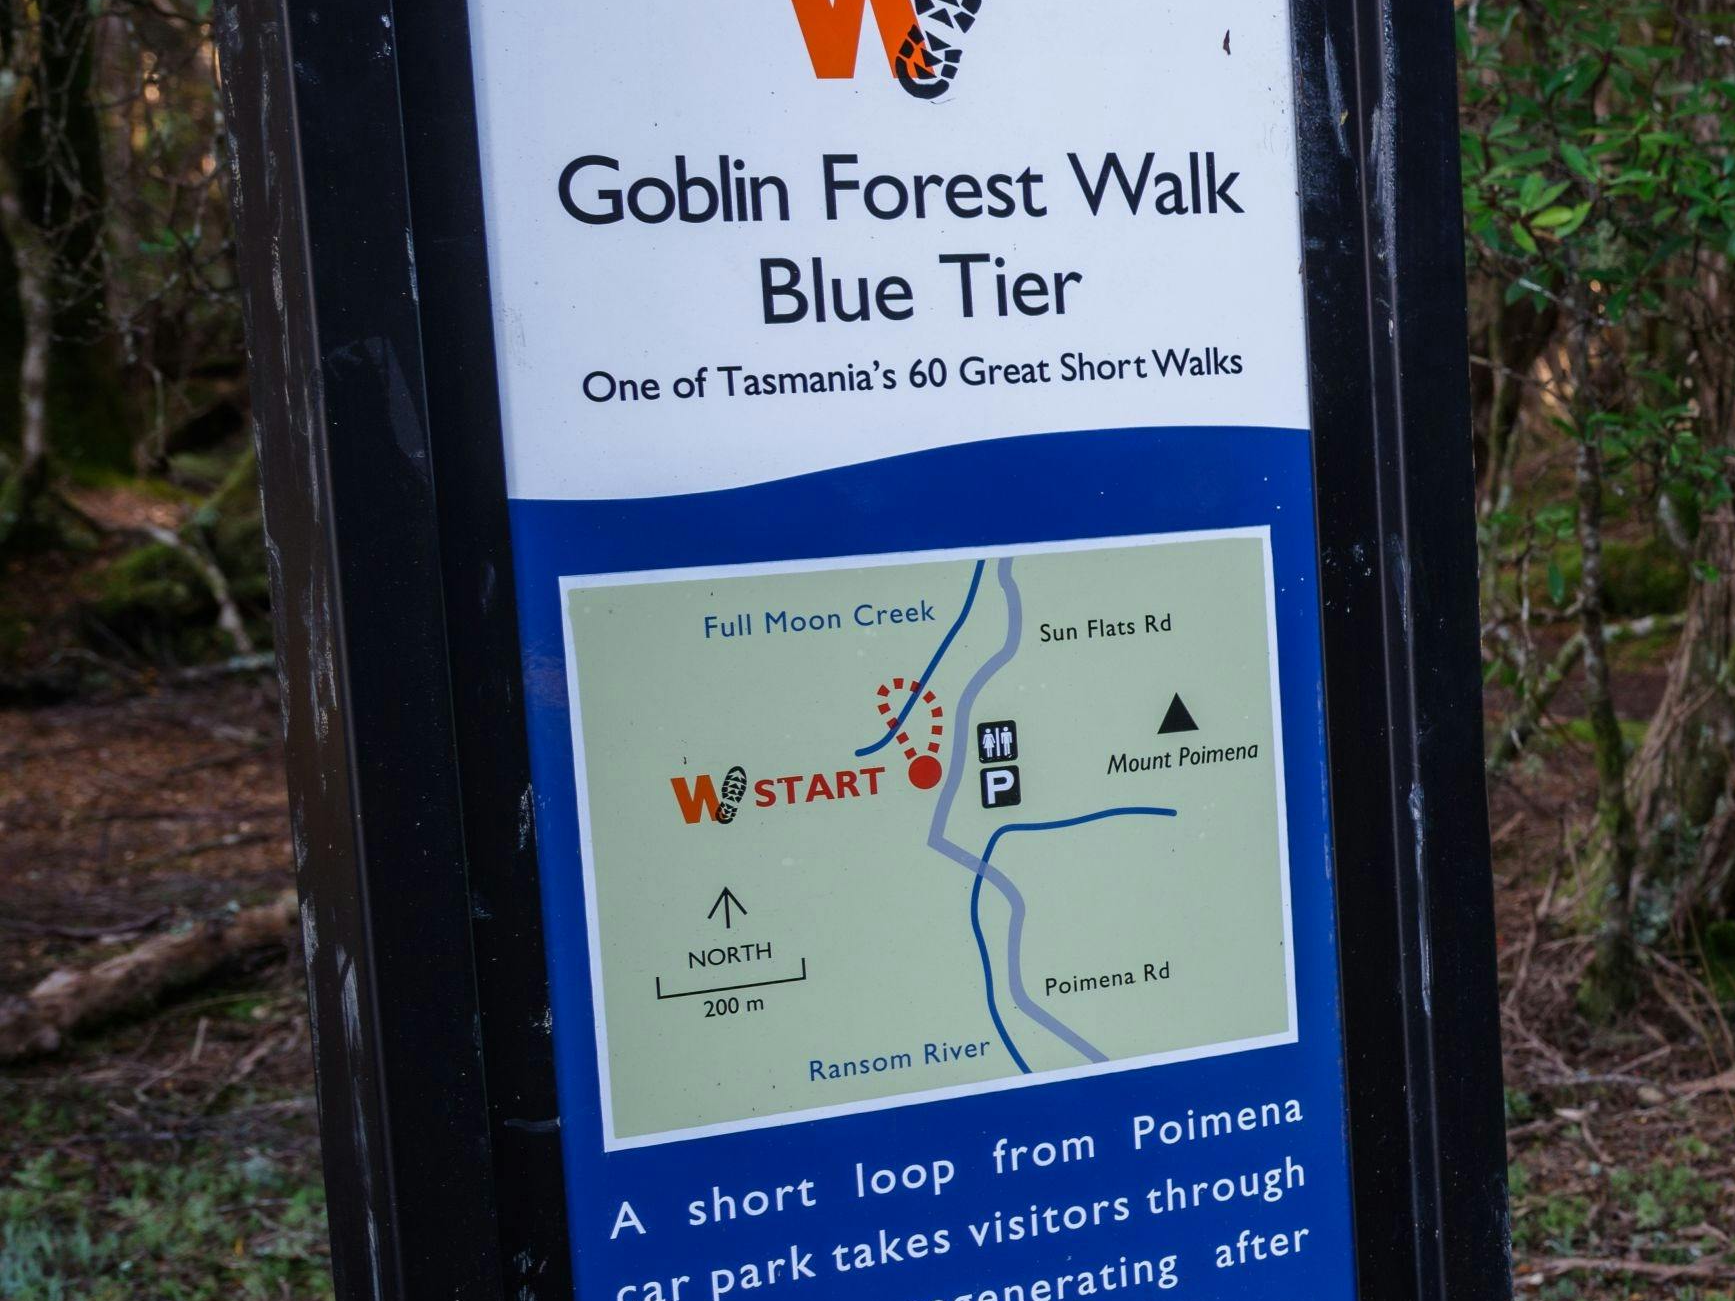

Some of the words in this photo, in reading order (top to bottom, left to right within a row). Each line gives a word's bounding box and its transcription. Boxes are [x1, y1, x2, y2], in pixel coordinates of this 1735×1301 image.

[557, 154, 790, 226] Goblin
[822, 153, 1048, 221] Forest
[1066, 151, 1245, 217] Walk
[759, 256, 914, 325] Blue
[938, 252, 1083, 318] Tier
[582, 370, 661, 403] One
[672, 366, 709, 399] of
[716, 359, 897, 397] Tasmania's
[909, 357, 948, 389] 60
[959, 355, 1052, 386] Great
[1060, 352, 1148, 382] Short
[1151, 346, 1243, 378] Walks
[704, 613, 752, 639] Full
[764, 610, 841, 634] Moon
[853, 599, 936, 627] Creek
[1040, 623, 1078, 643] Sun
[1087, 618, 1136, 639] Flats
[1144, 612, 1172, 634] Rd
[1106, 752, 1172, 775] Mount
[1178, 744, 1259, 767] Poimena
[753, 766, 886, 808] START
[986, 772, 1015, 801] P
[688, 941, 772, 969] NORTH
[1045, 967, 1135, 998] Poimena
[1143, 960, 1171, 984] Rd
[703, 996, 740, 1018] 200
[746, 998, 764, 1012] m
[809, 1053, 912, 1082] Ransom
[924, 1041, 991, 1065] River
[609, 1201, 647, 1240] A
[688, 1178, 817, 1226] short
[855, 1159, 955, 1198] loop
[992, 1135, 1095, 1174] from
[1133, 1099, 1304, 1150] Poimena
[831, 1229, 951, 1272] takes
[968, 1197, 1130, 1247] visitors
[1146, 1155, 1305, 1214] through
[1215, 1228, 1310, 1269] after
